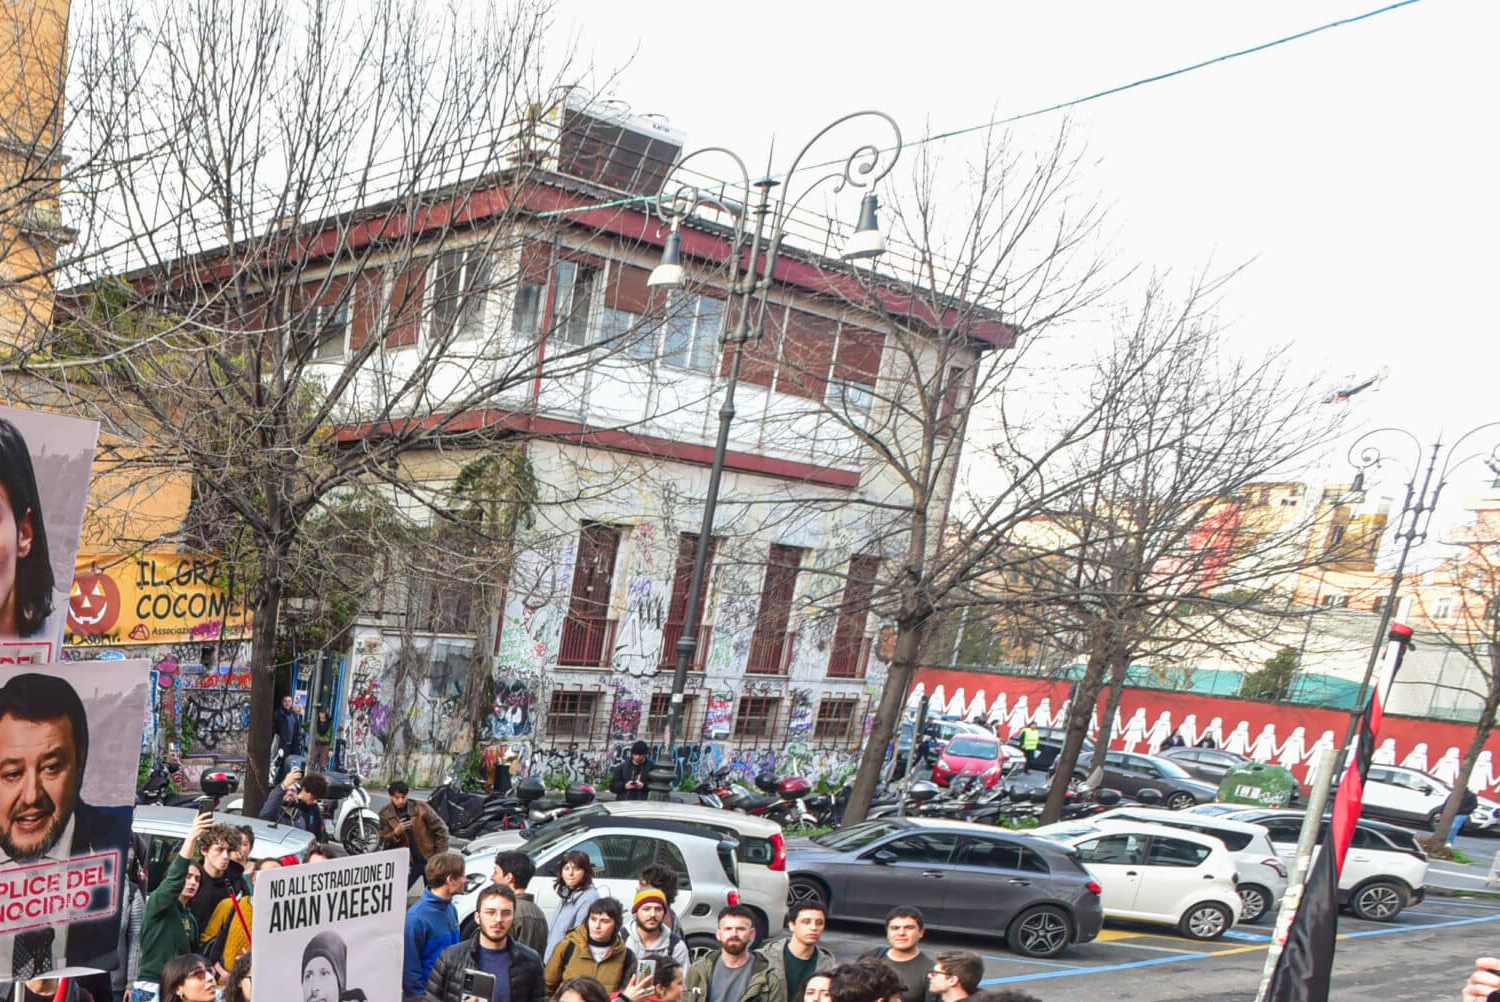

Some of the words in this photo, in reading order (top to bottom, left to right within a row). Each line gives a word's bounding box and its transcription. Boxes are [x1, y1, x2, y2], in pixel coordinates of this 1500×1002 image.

[136, 560, 164, 587] IL
[136, 593, 241, 619] COCOME
[66, 865, 111, 891] DEL
[269, 879, 286, 899] NO
[287, 864, 383, 897] ALL'ESTRADIZIONE
[385, 861, 396, 880] DI
[269, 893, 321, 934] ANAN
[326, 882, 393, 923] YAEESH
